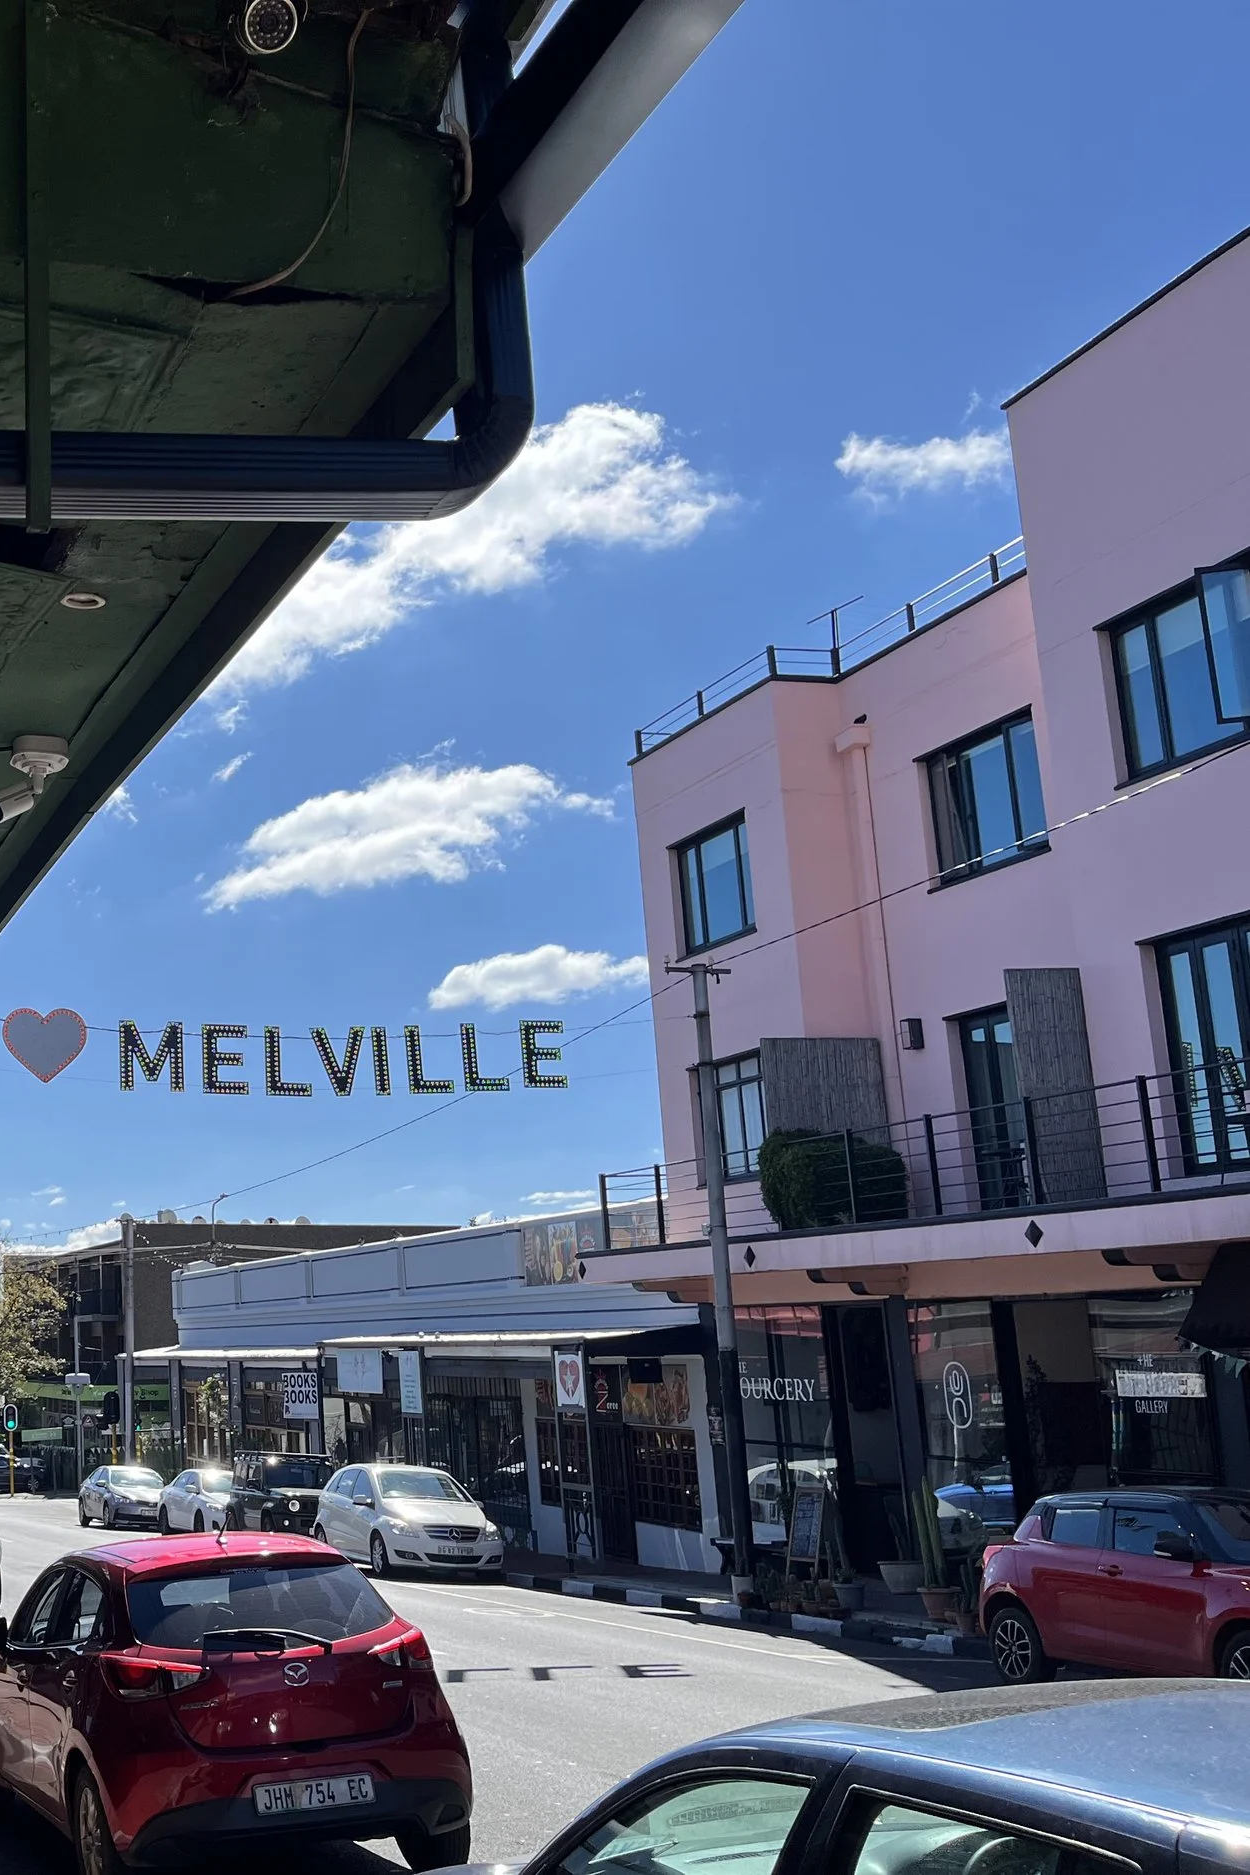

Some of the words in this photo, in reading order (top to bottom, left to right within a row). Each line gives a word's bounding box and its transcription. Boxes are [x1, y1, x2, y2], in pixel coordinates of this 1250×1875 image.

[118, 1018, 569, 1097] MELVILLE
[283, 1374, 317, 1389] BOOKS
[739, 1377, 815, 1402] OURCERY
[284, 1389, 318, 1404] BOOKS
[1135, 1399, 1168, 1414] GALLERY
[264, 1786, 295, 1810] JHM
[305, 1782, 336, 1805] 754
[347, 1777, 368, 1800] EC
